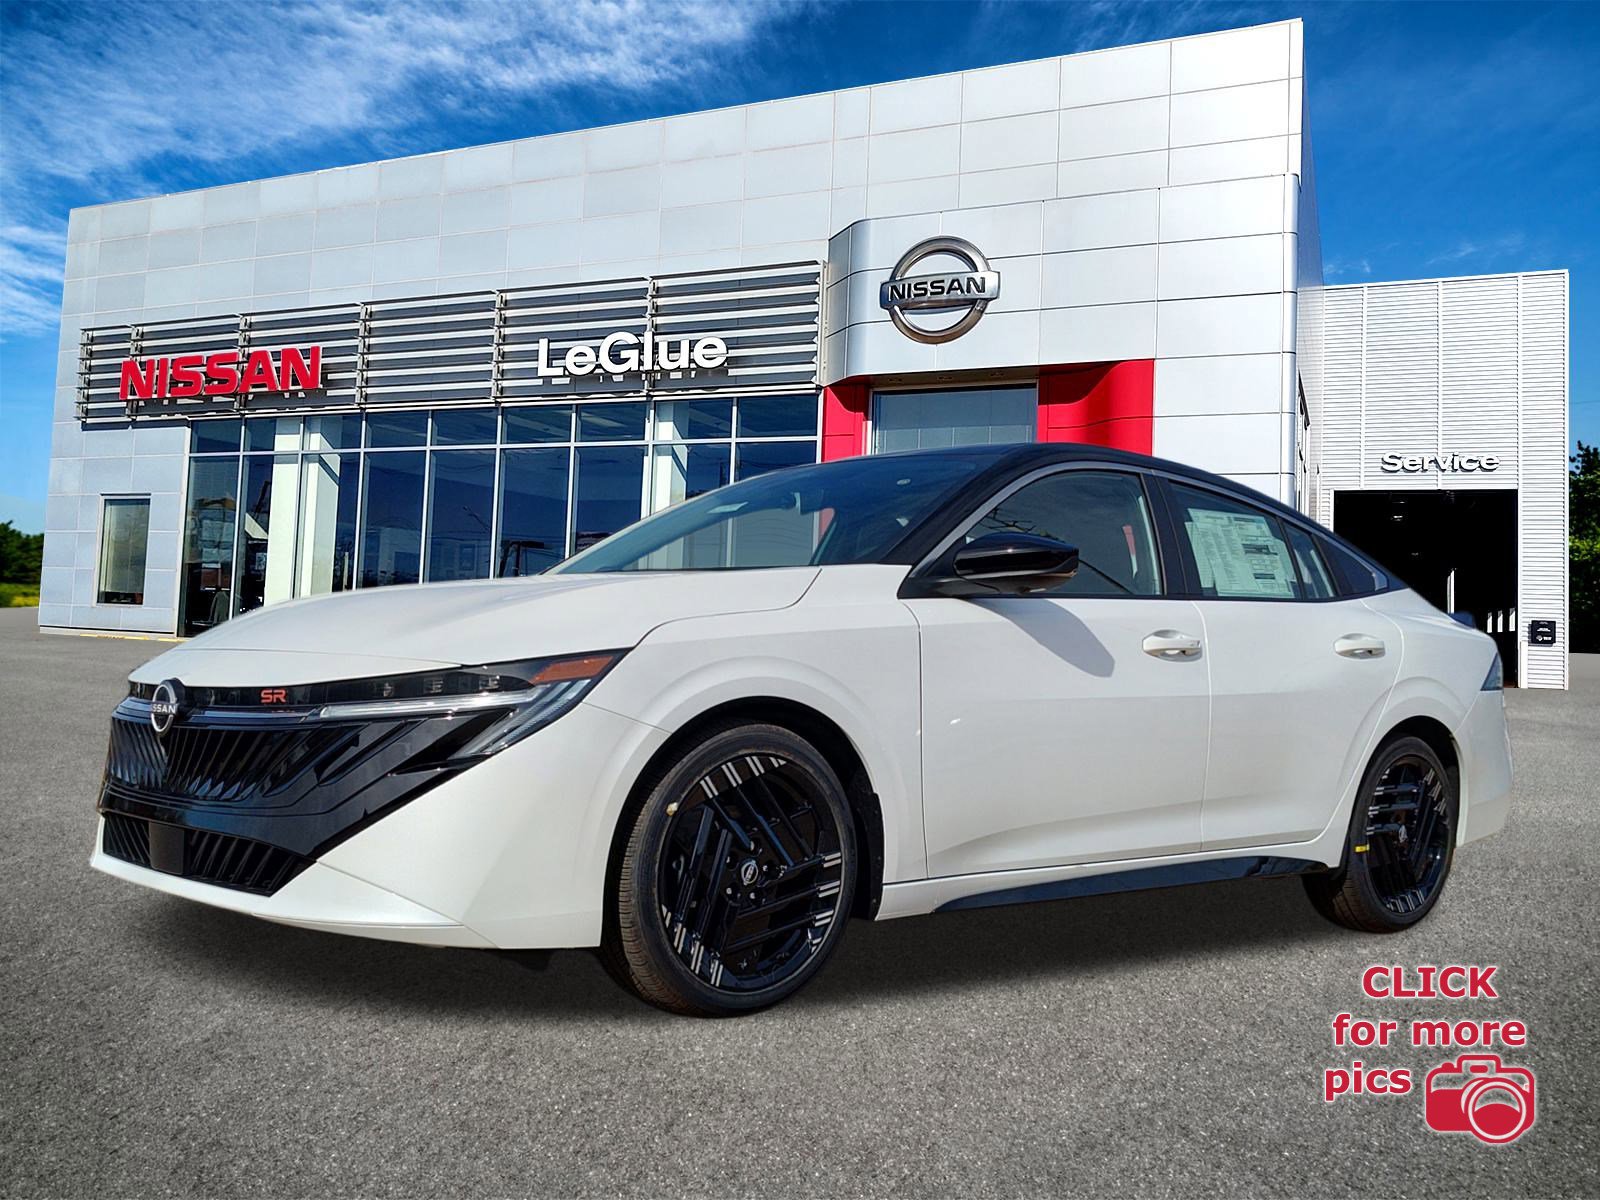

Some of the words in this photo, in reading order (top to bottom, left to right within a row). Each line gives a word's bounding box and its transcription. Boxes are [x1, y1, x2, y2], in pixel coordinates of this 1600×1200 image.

[887, 276, 986, 301] NISSAN
[537, 331, 728, 377] LeGlue
[119, 346, 322, 400] NISSAN
[1381, 451, 1500, 473] Service
[260, 689, 287, 703] SR
